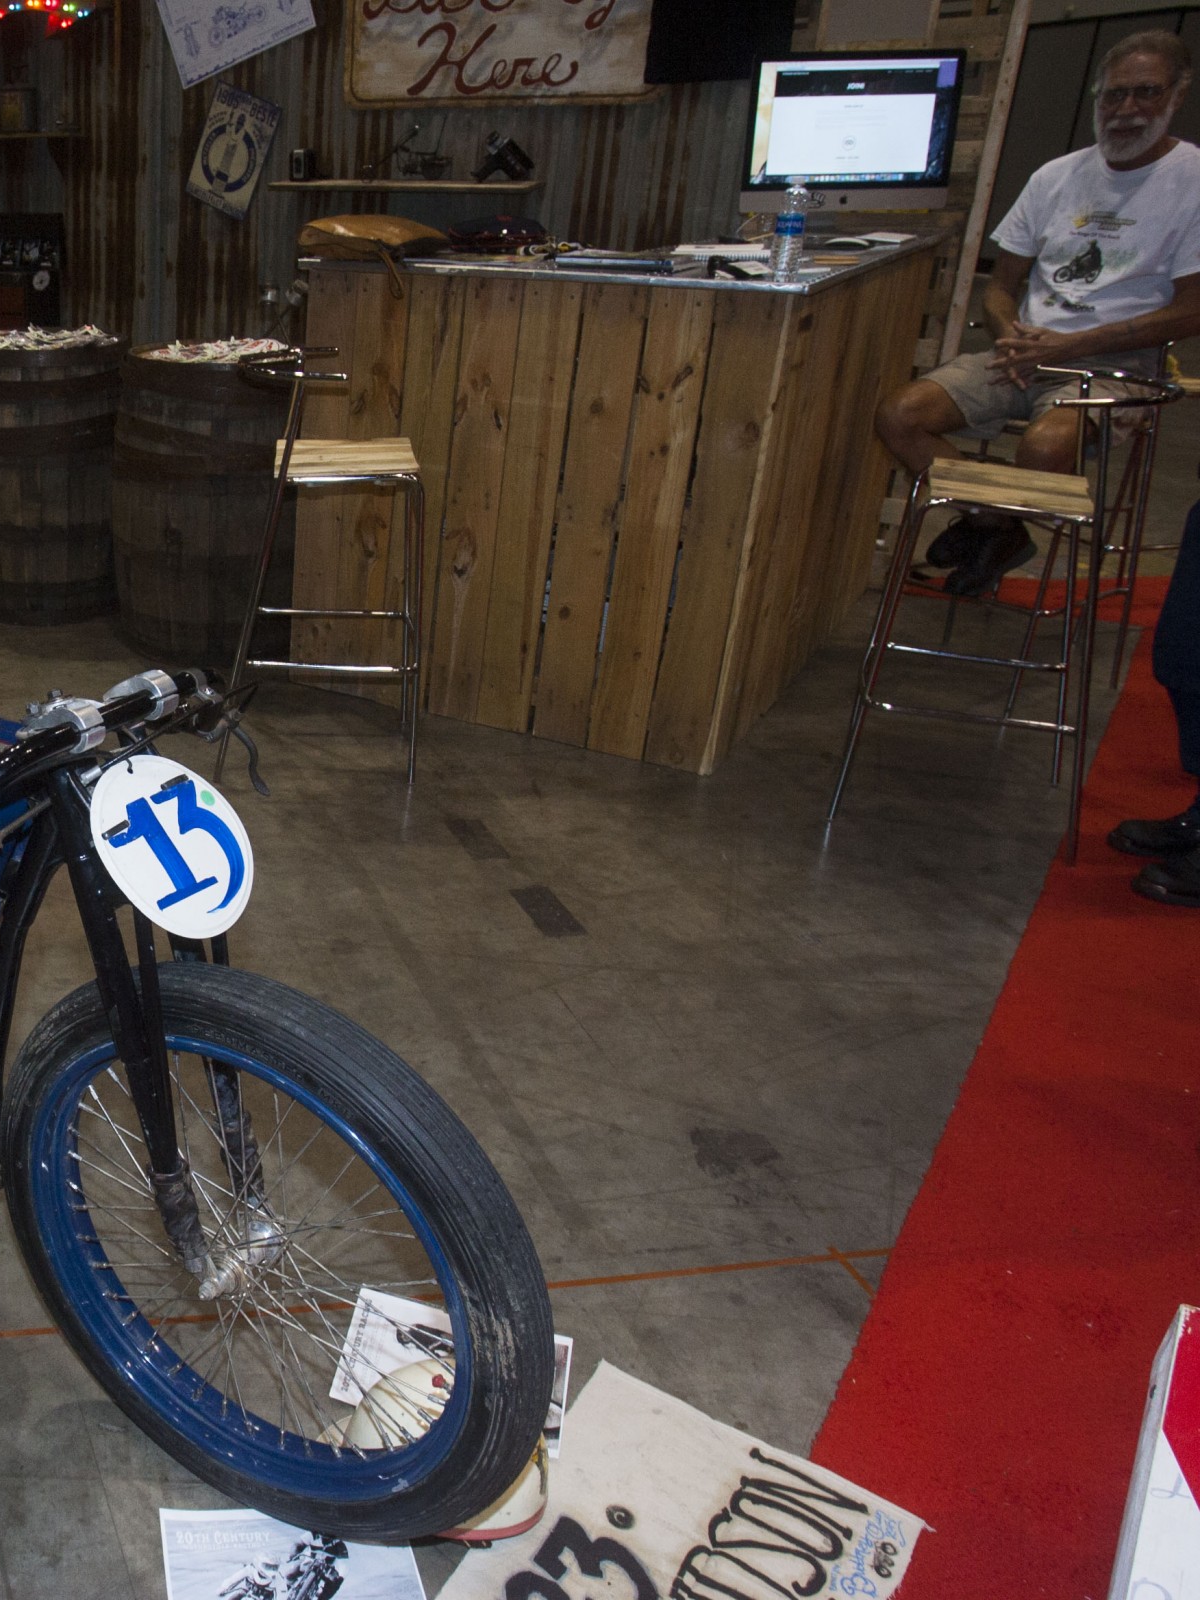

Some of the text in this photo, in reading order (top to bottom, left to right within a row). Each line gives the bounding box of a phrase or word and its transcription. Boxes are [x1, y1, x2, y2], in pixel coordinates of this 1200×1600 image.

[407, 22, 578, 96] Here
[103, 774, 245, 914] 13
[176, 1530, 209, 1545] 20TH
